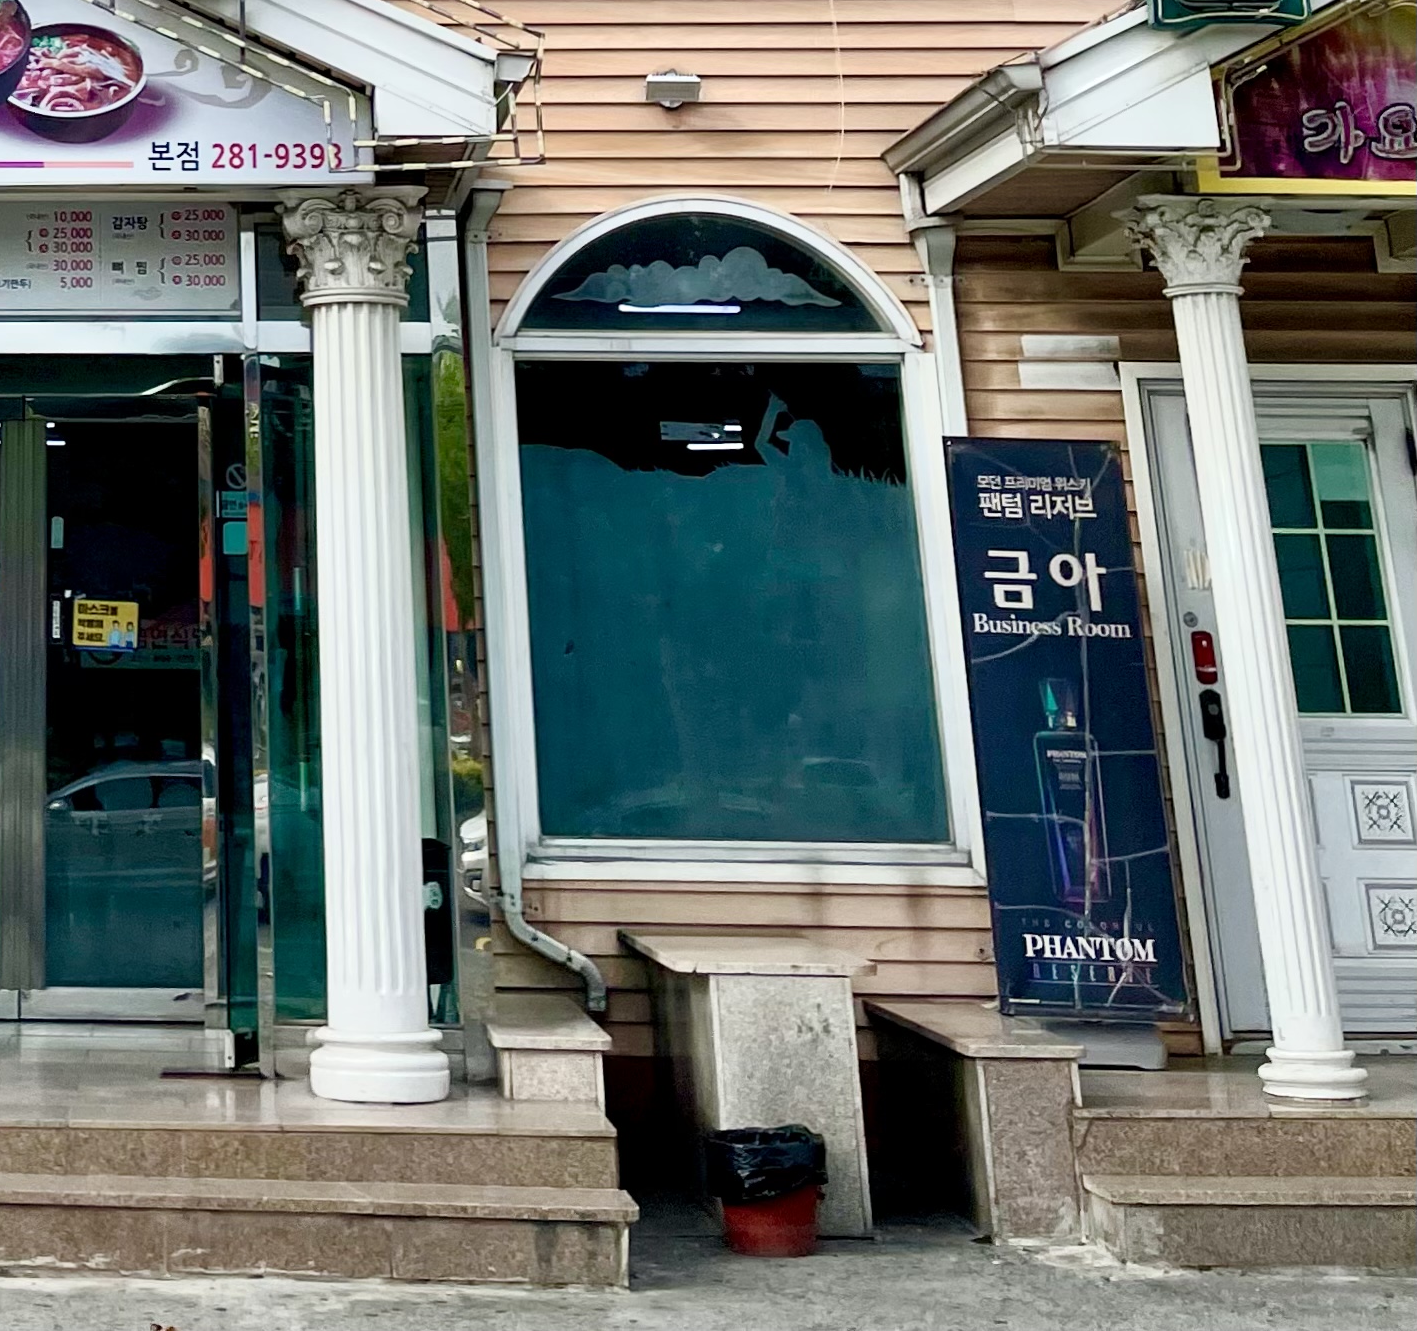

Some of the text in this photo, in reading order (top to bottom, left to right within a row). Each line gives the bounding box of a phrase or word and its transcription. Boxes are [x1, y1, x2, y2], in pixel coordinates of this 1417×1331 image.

[148, 141, 200, 171] 본점
[53, 211, 93, 224] 10,000
[184, 209, 225, 222] 25,000
[53, 227, 93, 241] 25,000
[184, 229, 225, 242] 30,000
[52, 241, 93, 254] 30,000
[53, 259, 93, 273] 30,000
[185, 254, 226, 267] 25,000
[60, 277, 93, 290] 5,000
[185, 275, 226, 288] 30,000
[977, 475, 1002, 489] 모던
[1004, 476, 1053, 491] 프리미엄
[978, 492, 1098, 520] 팬텀 리저브
[983, 549, 1107, 612] 금아
[973, 613, 1133, 638] Business Room
[1022, 933, 1158, 963] PHANTOM
